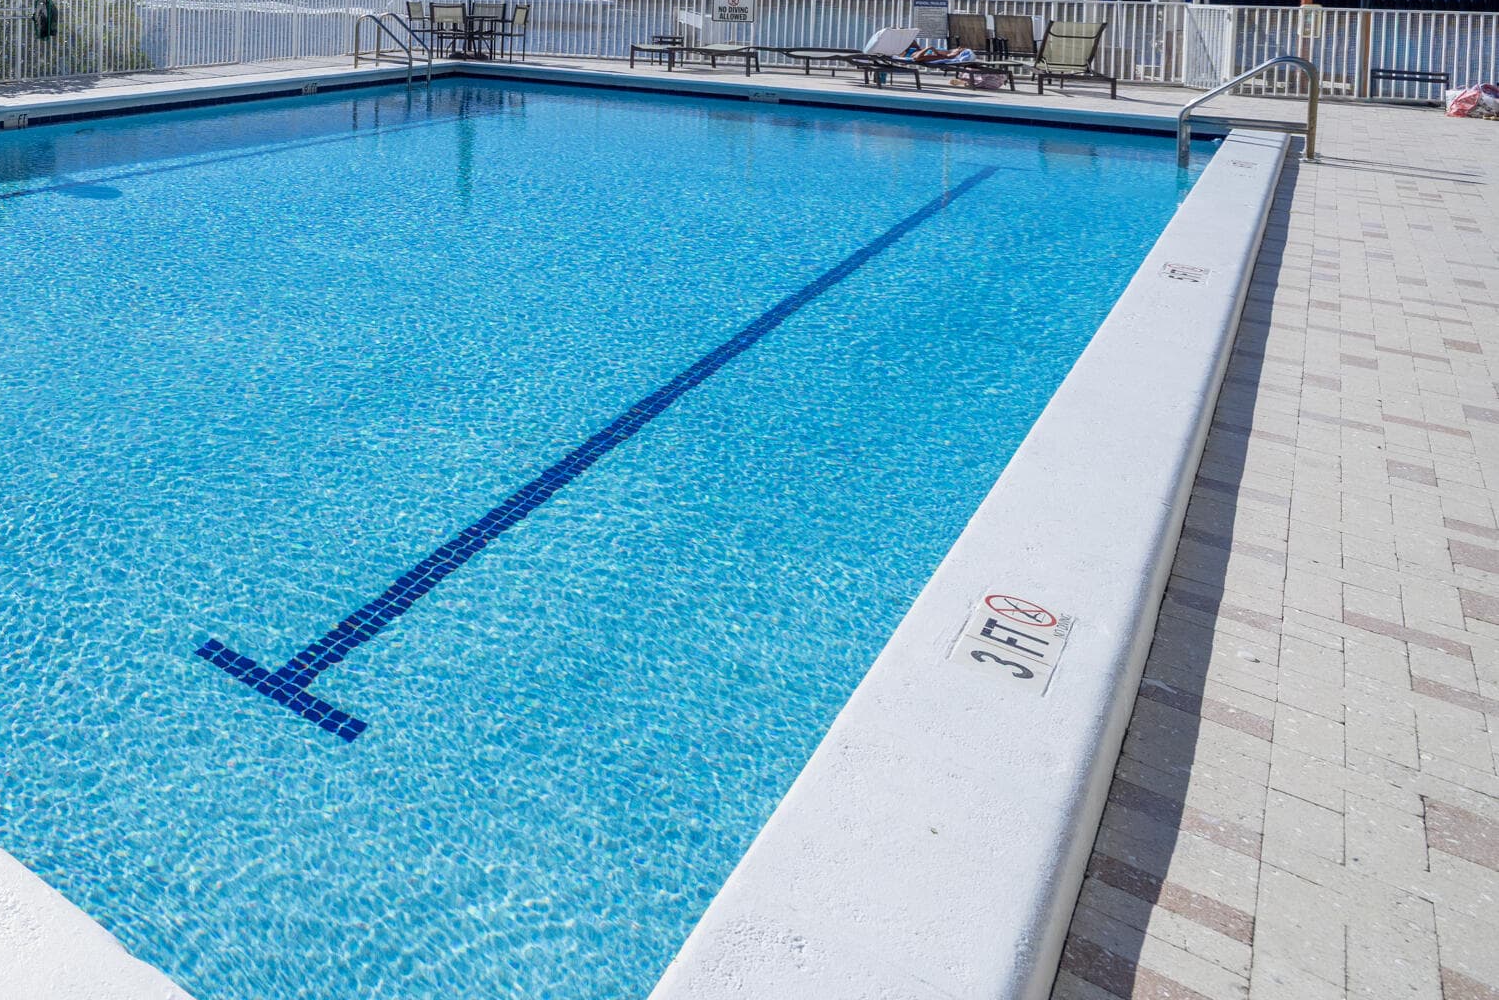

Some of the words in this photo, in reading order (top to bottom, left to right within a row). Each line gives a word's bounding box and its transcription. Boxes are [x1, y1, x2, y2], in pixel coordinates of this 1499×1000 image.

[719, 13, 747, 21] ALLOWED
[728, 6, 749, 14] DIVING
[980, 617, 1049, 658] FT
[970, 650, 1034, 679] 3
